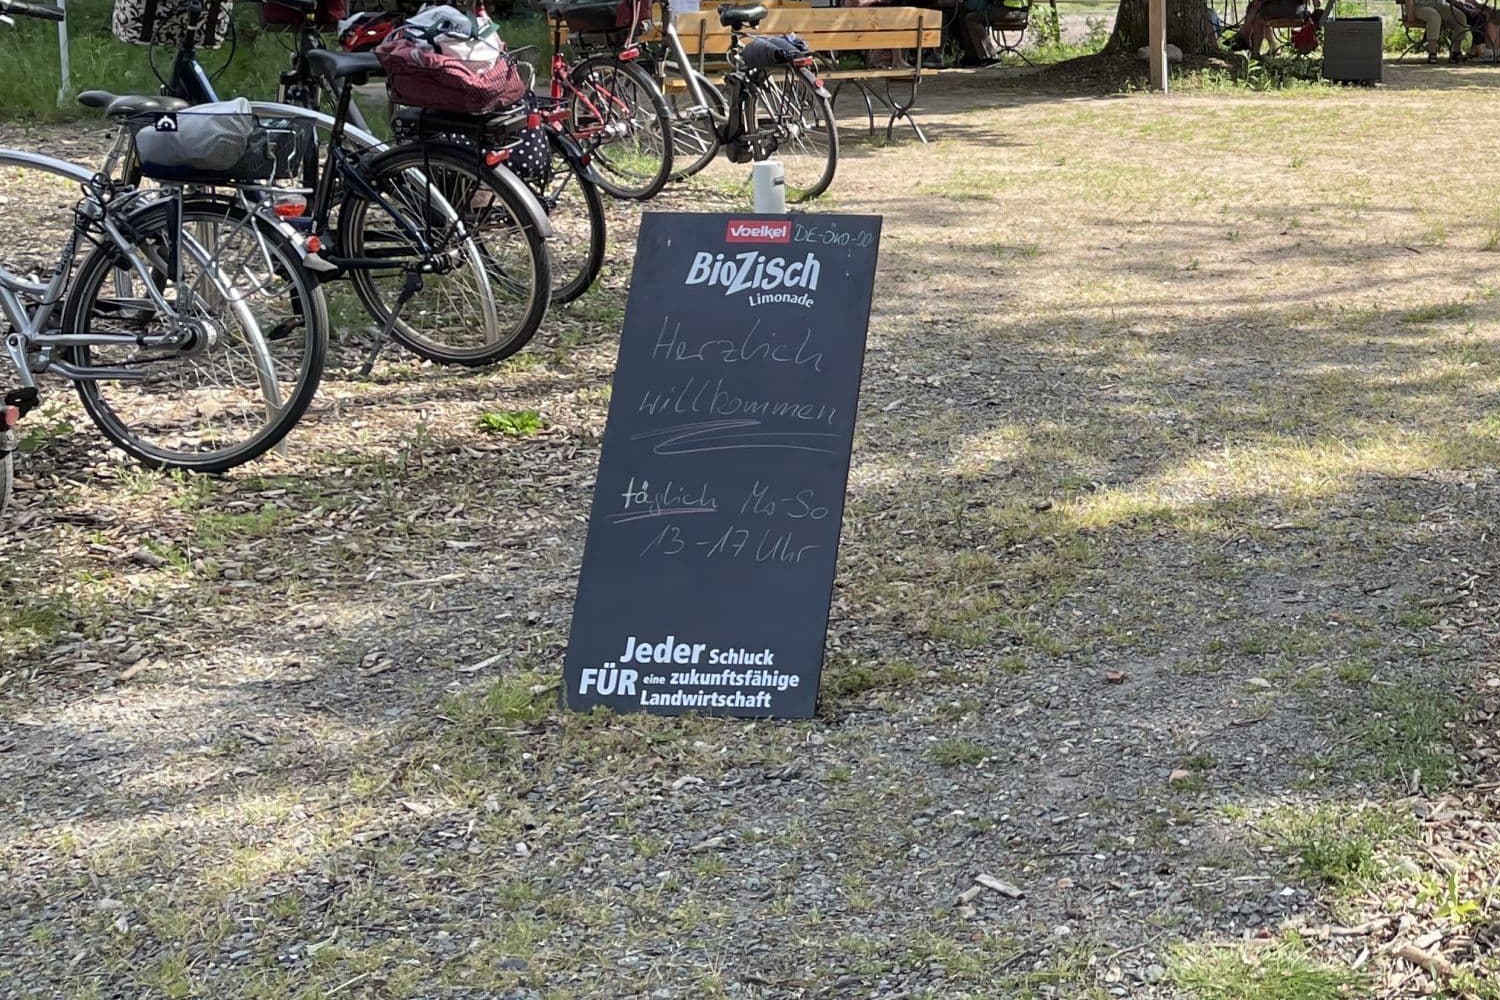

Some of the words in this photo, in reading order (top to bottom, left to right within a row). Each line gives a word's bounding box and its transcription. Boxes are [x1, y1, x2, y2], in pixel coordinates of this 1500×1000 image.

[730, 224, 788, 239] Voelkel
[685, 250, 821, 297] BioZisch
[749, 292, 814, 309] Limonade
[652, 316, 822, 372] Herzlich
[621, 477, 719, 516] täglich
[755, 529, 820, 563] Uhr
[620, 636, 706, 664] Jeder
[708, 649, 775, 666] Schluck
[578, 662, 639, 696] FÜR
[642, 674, 666, 685] eine
[670, 669, 800, 690] zukunftsfähige
[640, 690, 772, 708] Landwirtschaft
